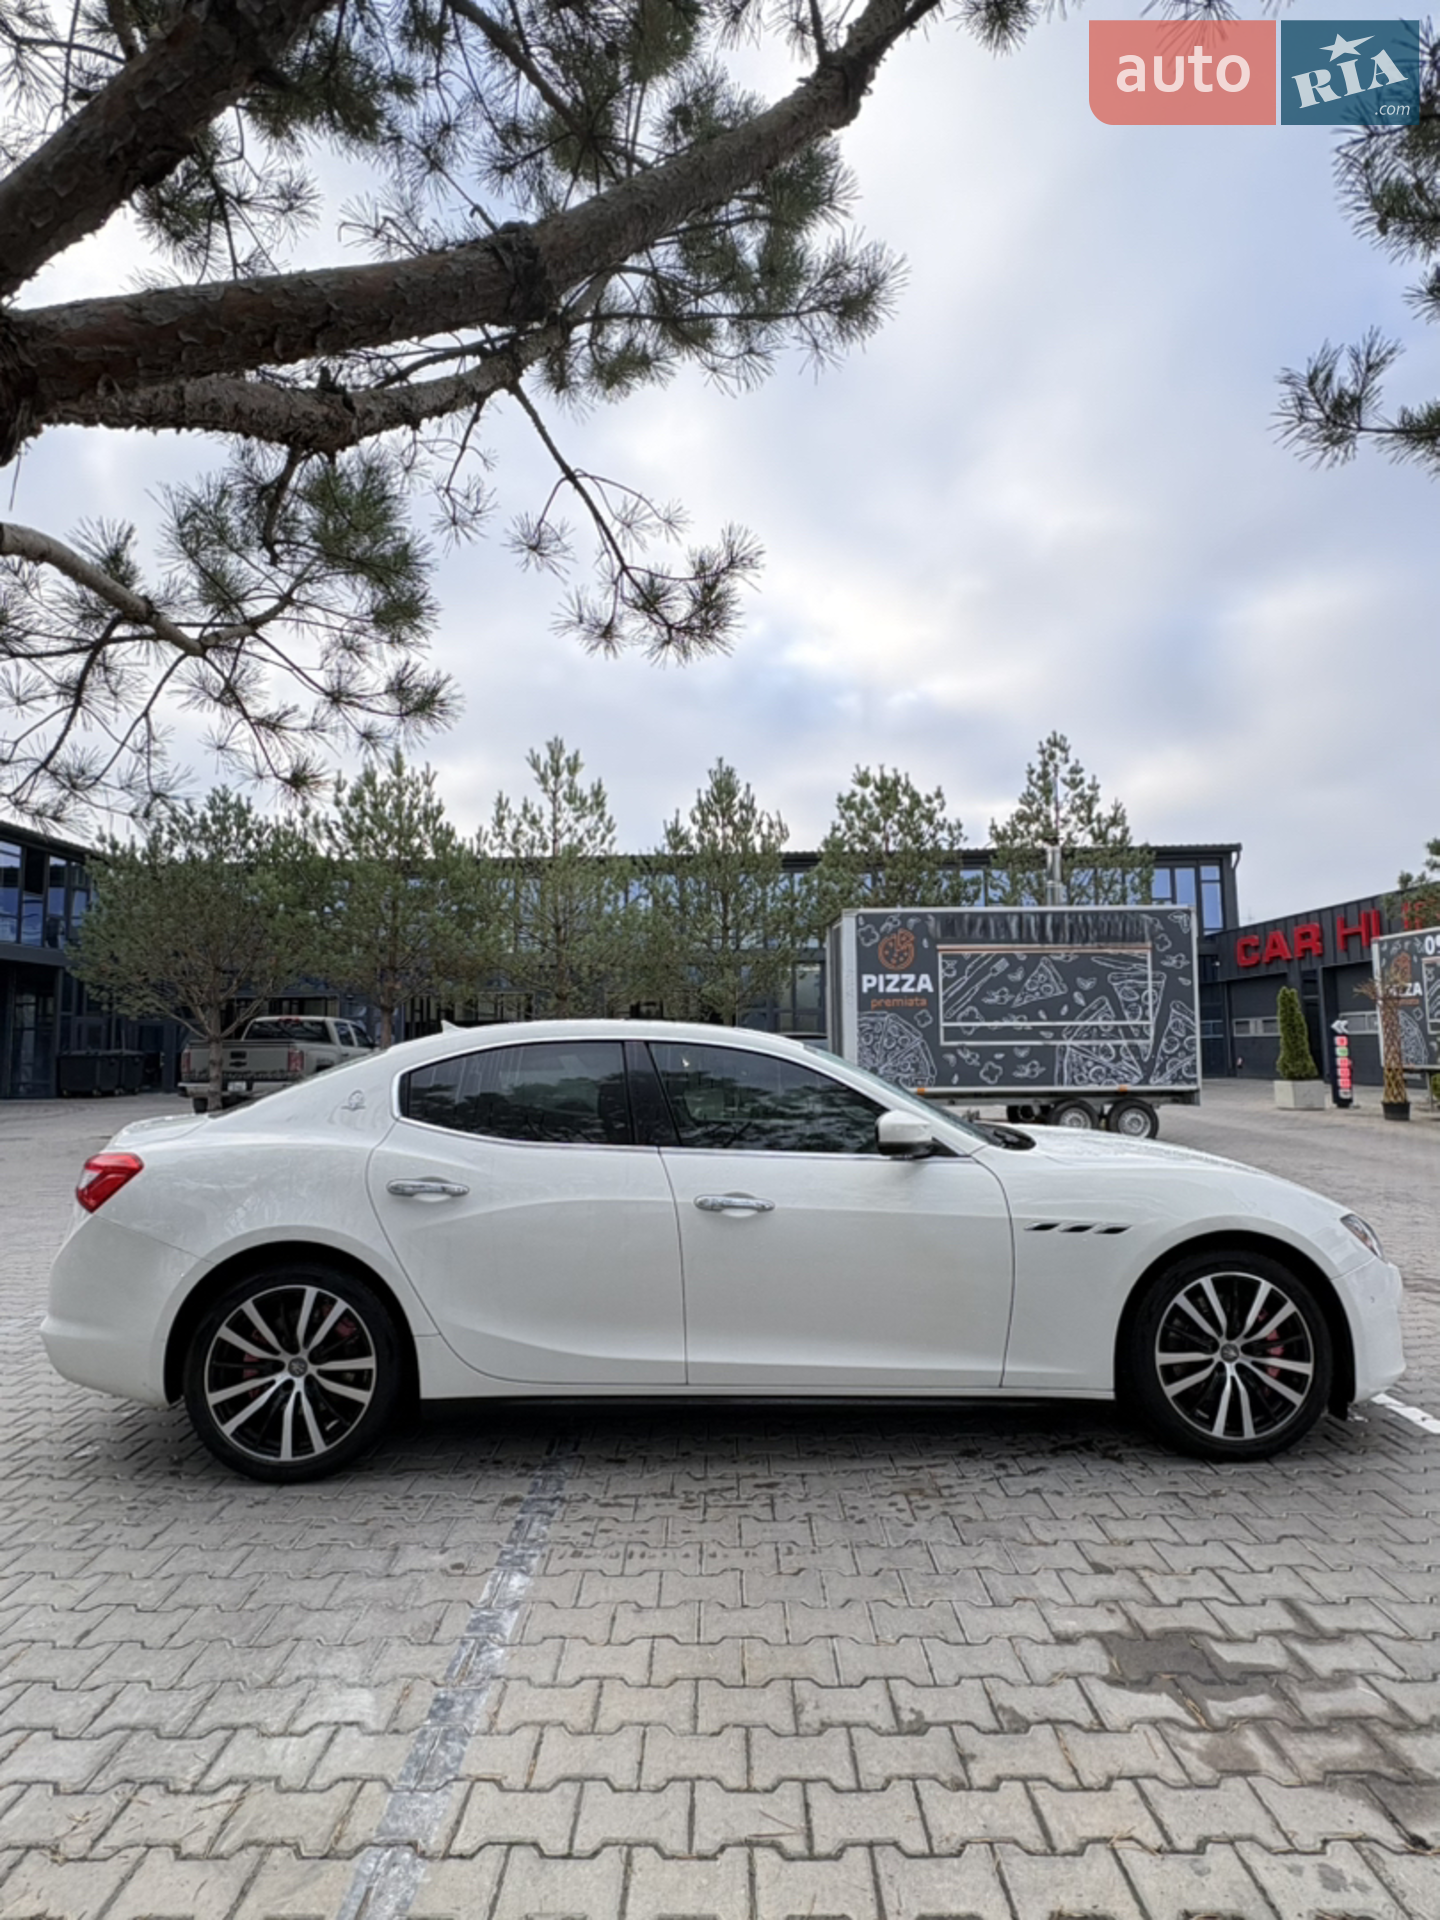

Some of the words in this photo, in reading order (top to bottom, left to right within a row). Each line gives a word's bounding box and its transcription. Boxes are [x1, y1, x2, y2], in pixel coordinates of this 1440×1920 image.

[1236, 921, 1324, 968] CAR
[861, 973, 934, 993] PIZZA
[871, 996, 928, 1011] premiata
